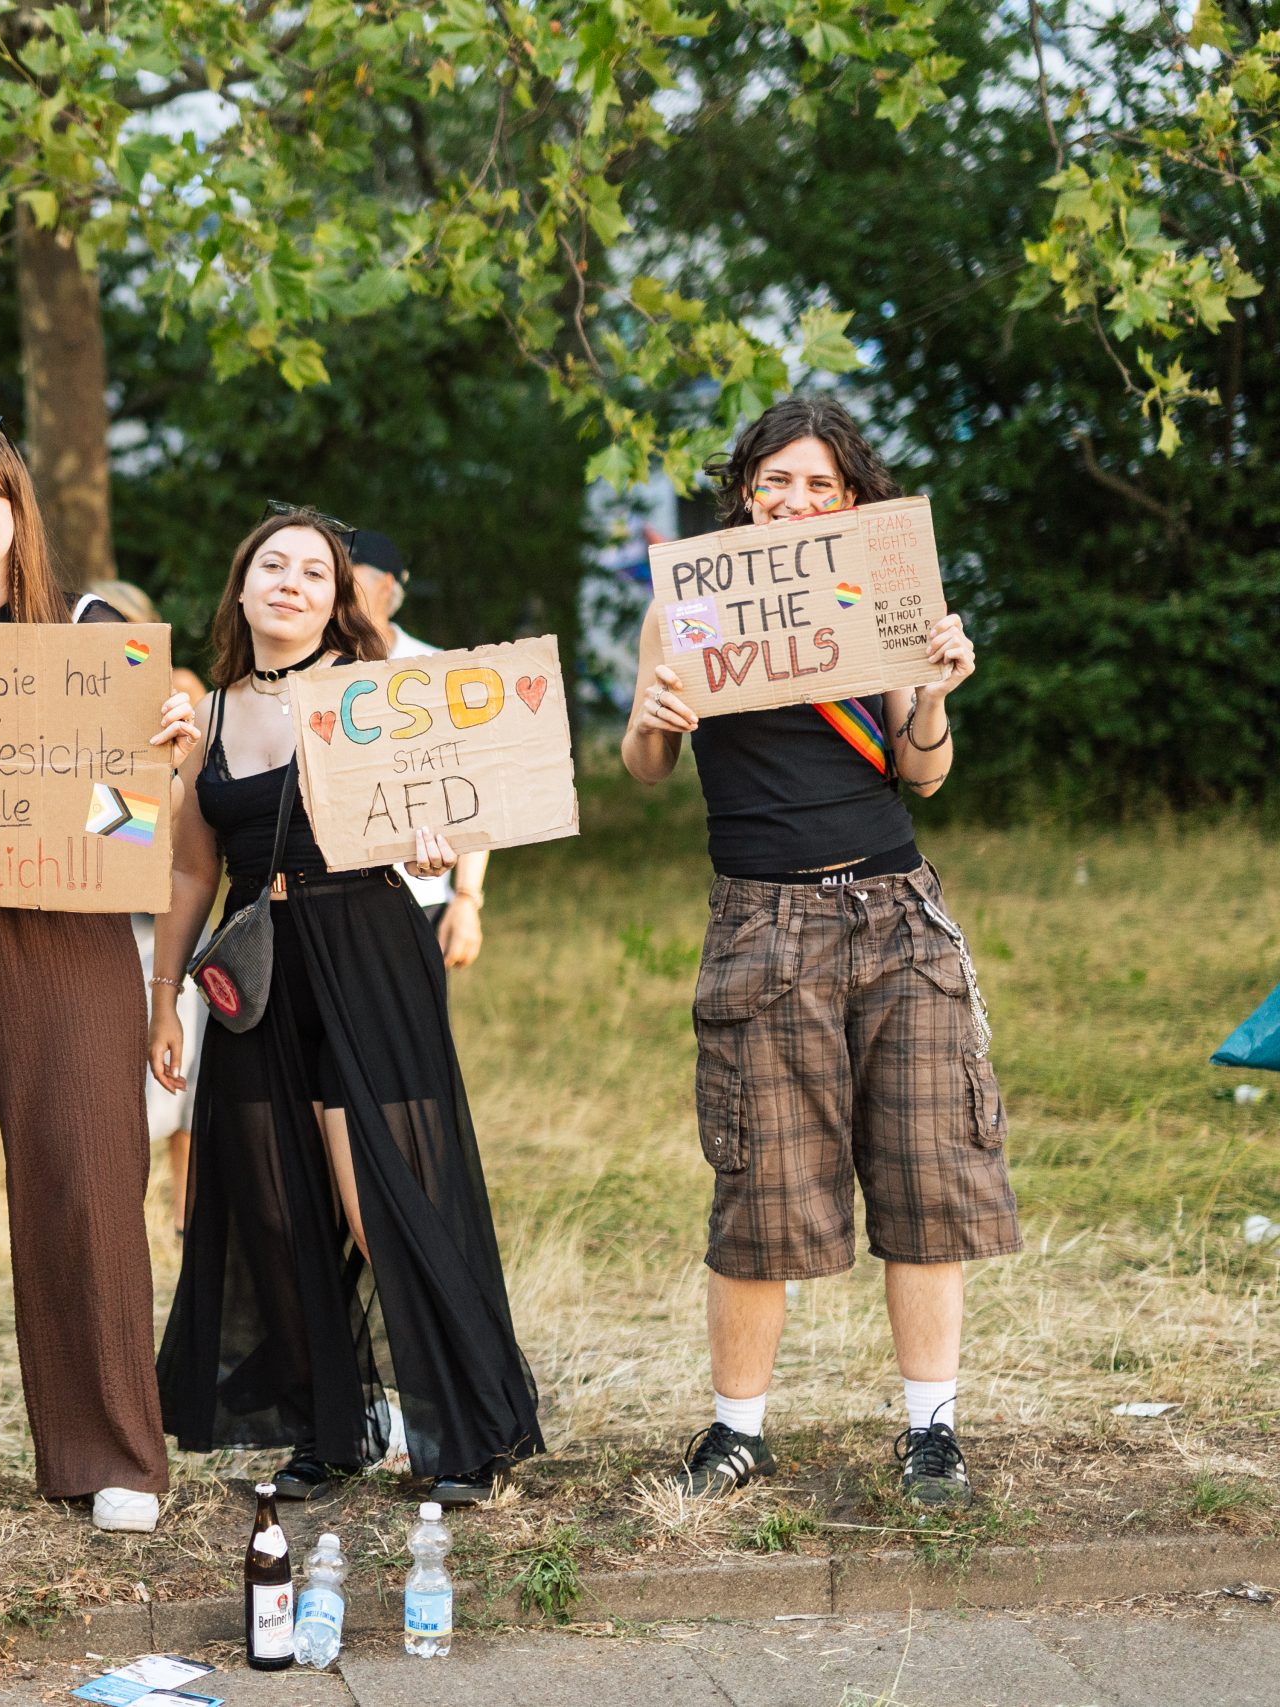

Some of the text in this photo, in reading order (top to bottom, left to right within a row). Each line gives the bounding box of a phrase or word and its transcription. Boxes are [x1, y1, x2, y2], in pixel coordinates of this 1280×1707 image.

[861, 512, 912, 535] TRANS
[868, 533, 918, 552] RIGHTS
[672, 534, 843, 600] PROTECT
[881, 552, 905, 567] ARE
[871, 564, 916, 581] HUMAN
[874, 576, 921, 594] RIGHTS
[726, 590, 811, 635] THE
[875, 595, 921, 611] NO CSD
[876, 608, 923, 627] WITHOUT
[879, 623, 918, 638] MARSHA
[882, 635, 928, 650] JOHNSON
[66, 659, 111, 697] hat
[340, 667, 505, 745] CSD
[393, 739, 467, 774] STATT
[363, 775, 479, 836] AFD
[259, 1614, 287, 1629] Berliner
